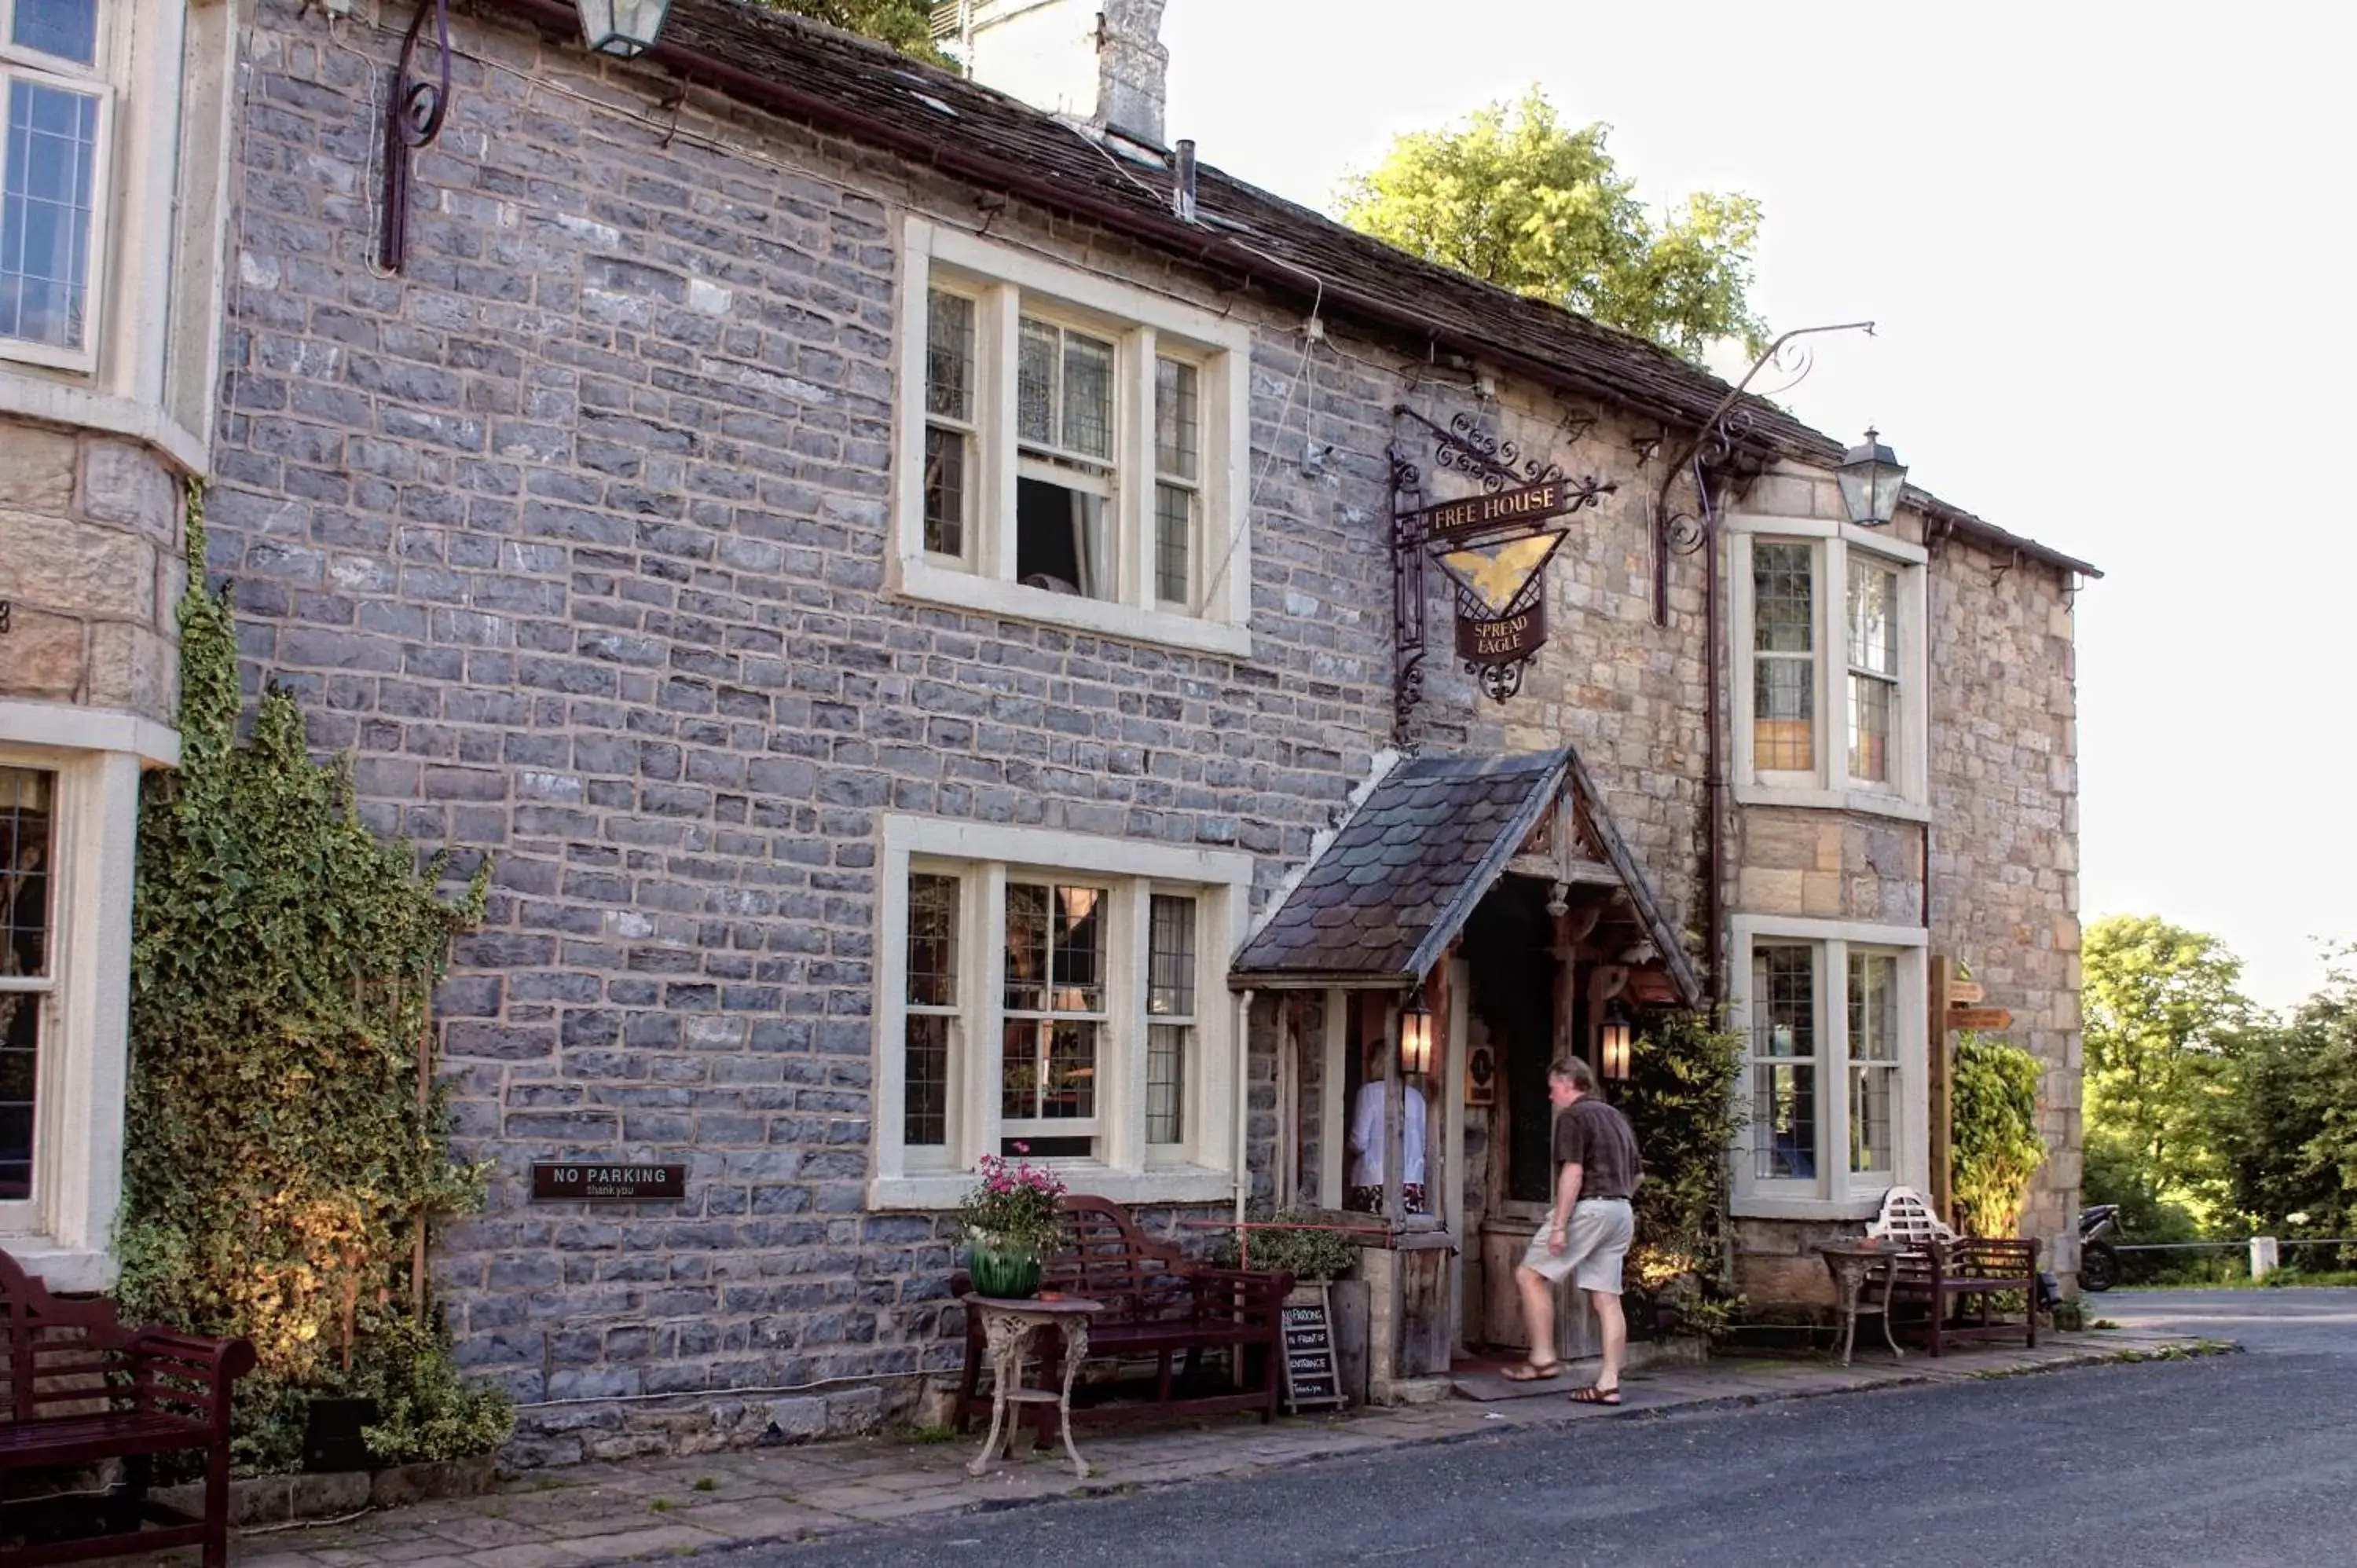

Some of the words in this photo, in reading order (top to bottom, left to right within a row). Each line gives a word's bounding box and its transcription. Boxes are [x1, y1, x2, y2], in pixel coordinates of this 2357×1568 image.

[1435, 504, 1476, 529] FREE
[1484, 487, 1554, 519] HOUSE
[1474, 615, 1528, 637] SPREAD
[1478, 633, 1523, 654] EAGLE
[554, 1167, 579, 1182] NO
[587, 1167, 665, 1182] PARKING
